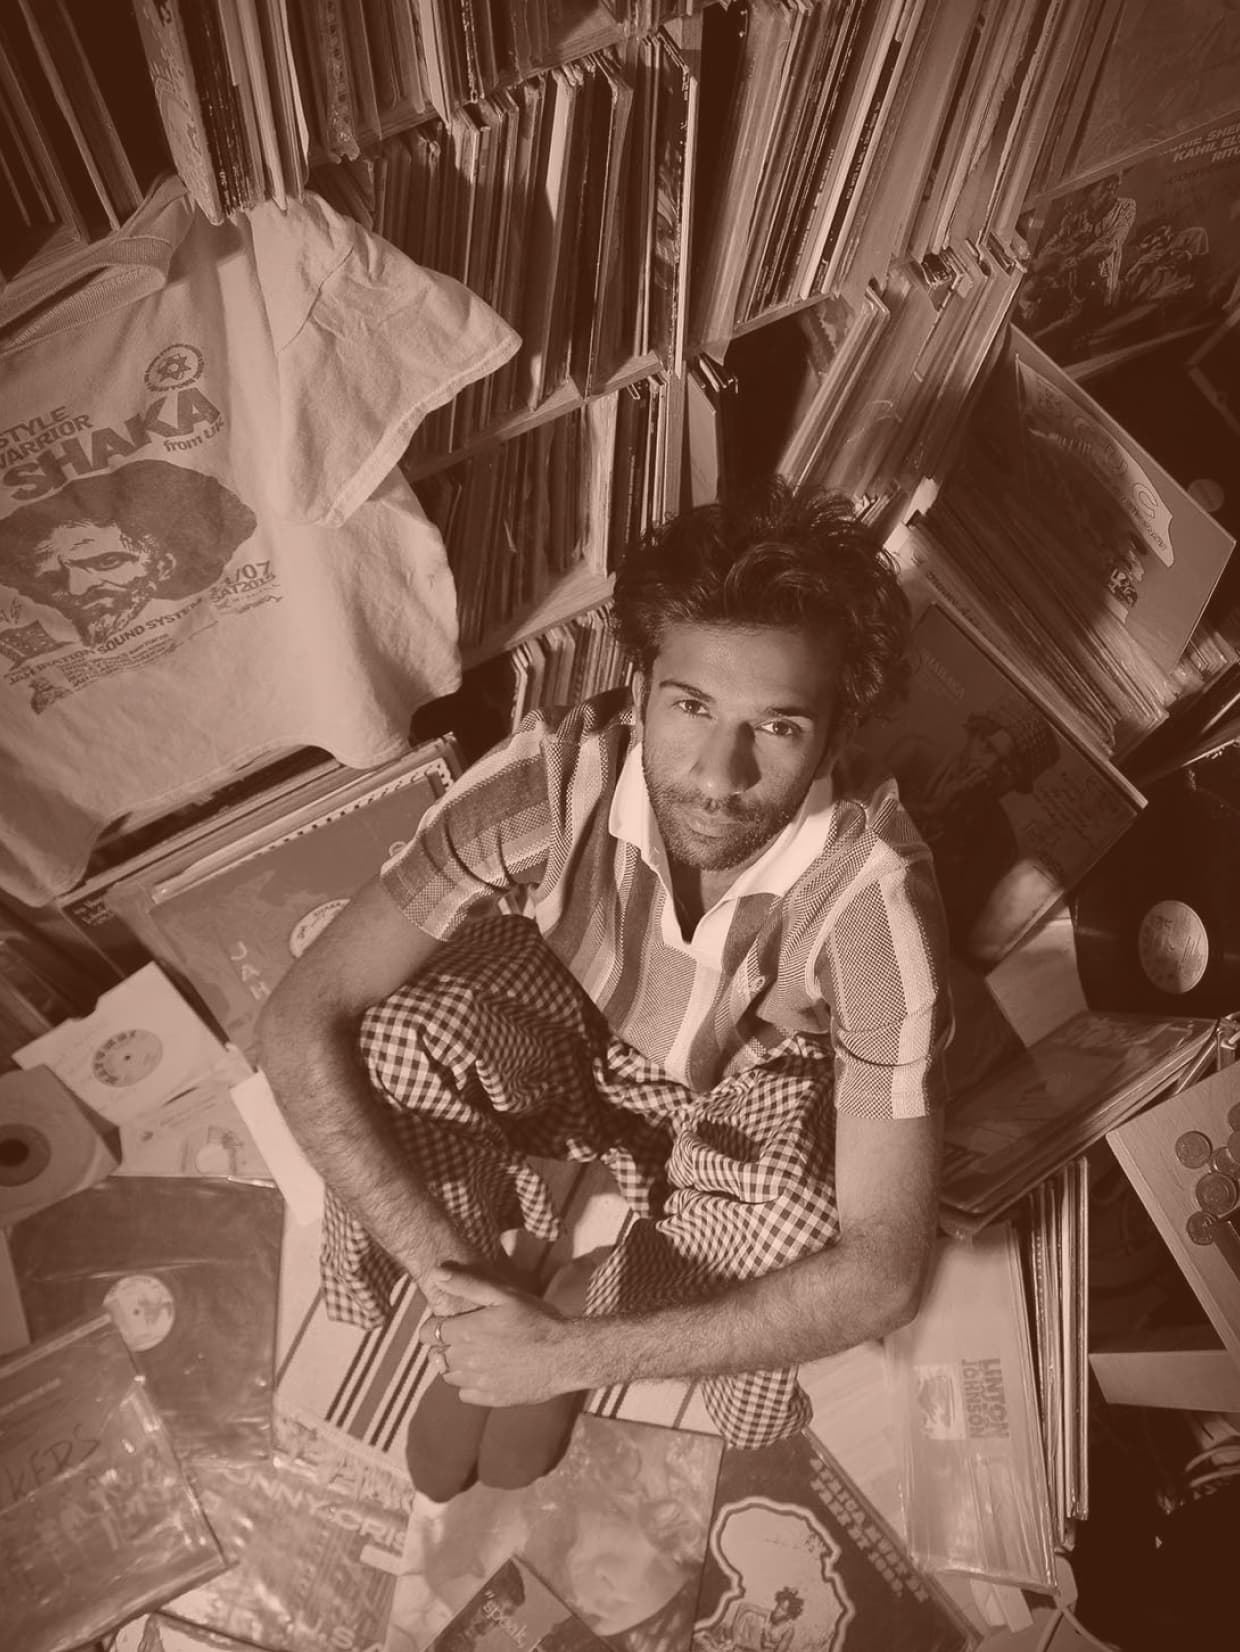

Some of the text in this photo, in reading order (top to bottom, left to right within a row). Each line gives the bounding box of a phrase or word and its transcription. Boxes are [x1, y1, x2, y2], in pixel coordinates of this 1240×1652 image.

[2, 387, 221, 500] SHAKA
[163, 434, 204, 453] from
[97, 624, 146, 656] SOUND
[961, 1359, 985, 1438] JOHNSON
[981, 1358, 1010, 1439] LINTON
